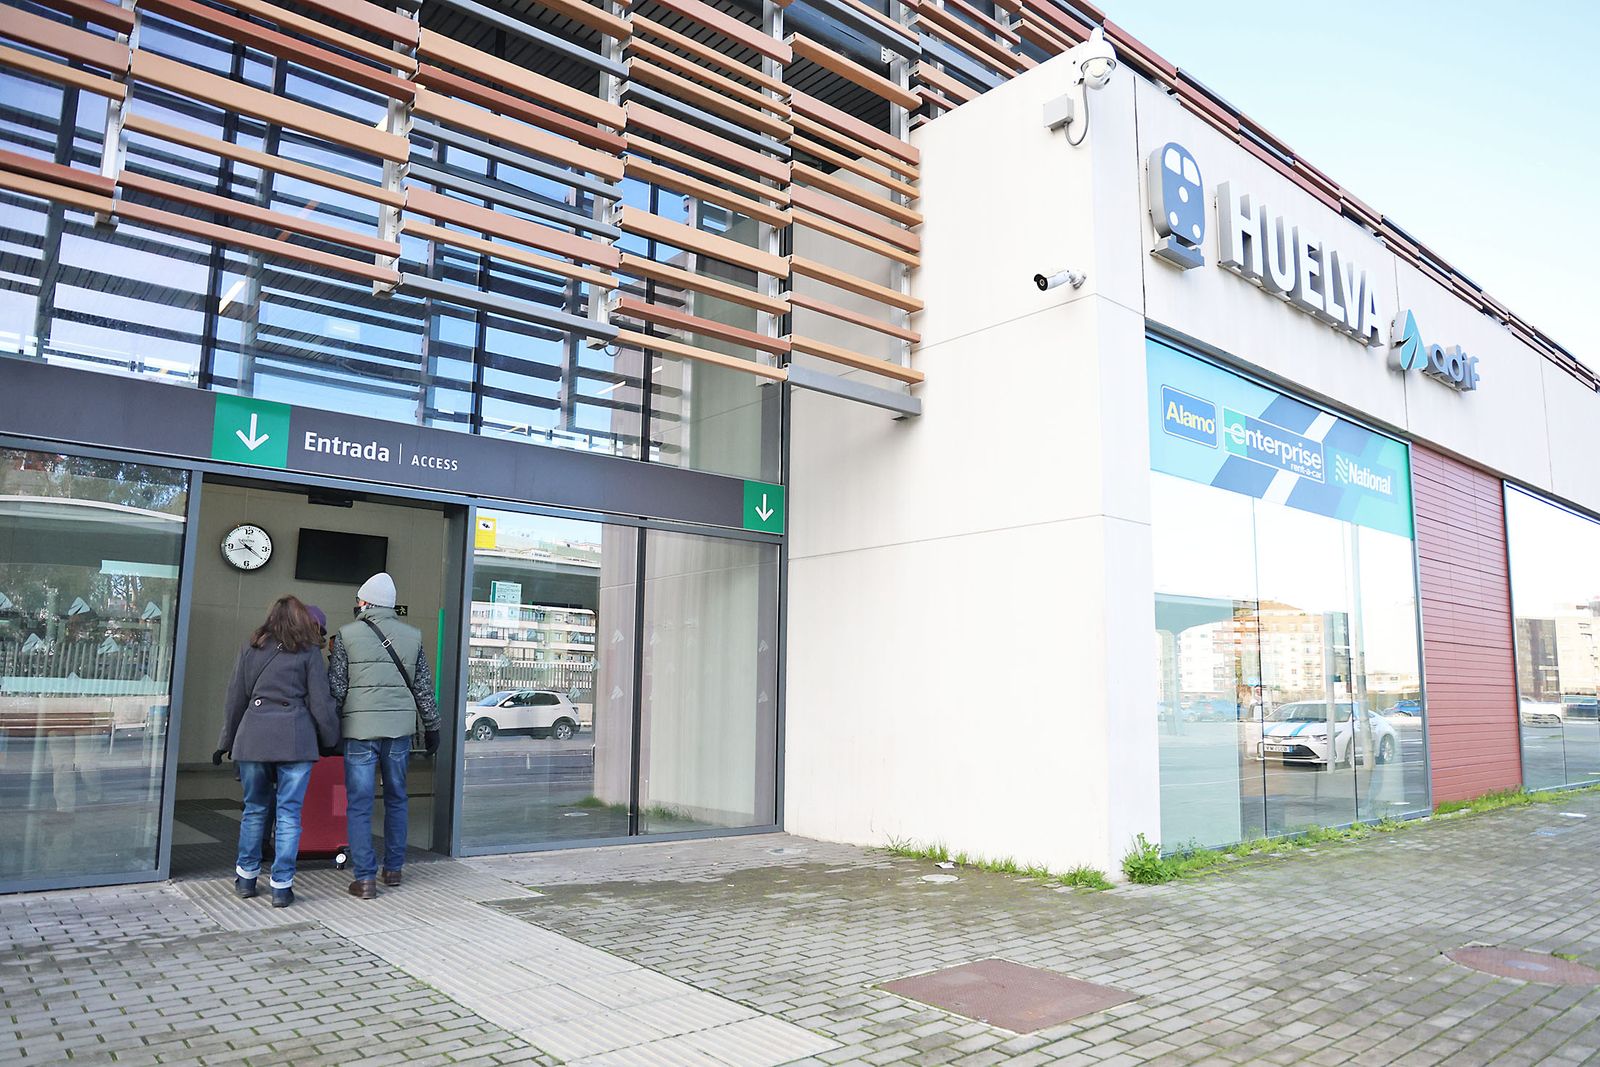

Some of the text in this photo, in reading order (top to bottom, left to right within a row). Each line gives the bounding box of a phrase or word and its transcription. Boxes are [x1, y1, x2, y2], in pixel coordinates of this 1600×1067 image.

[1218, 180, 1383, 346] HUELVA
[1429, 343, 1480, 391] adif
[1166, 401, 1215, 434] Alamo
[304, 431, 390, 462] Entrada
[411, 454, 458, 471] ACCESS
[1228, 423, 1323, 470] enterprise
[1348, 461, 1392, 495] National
